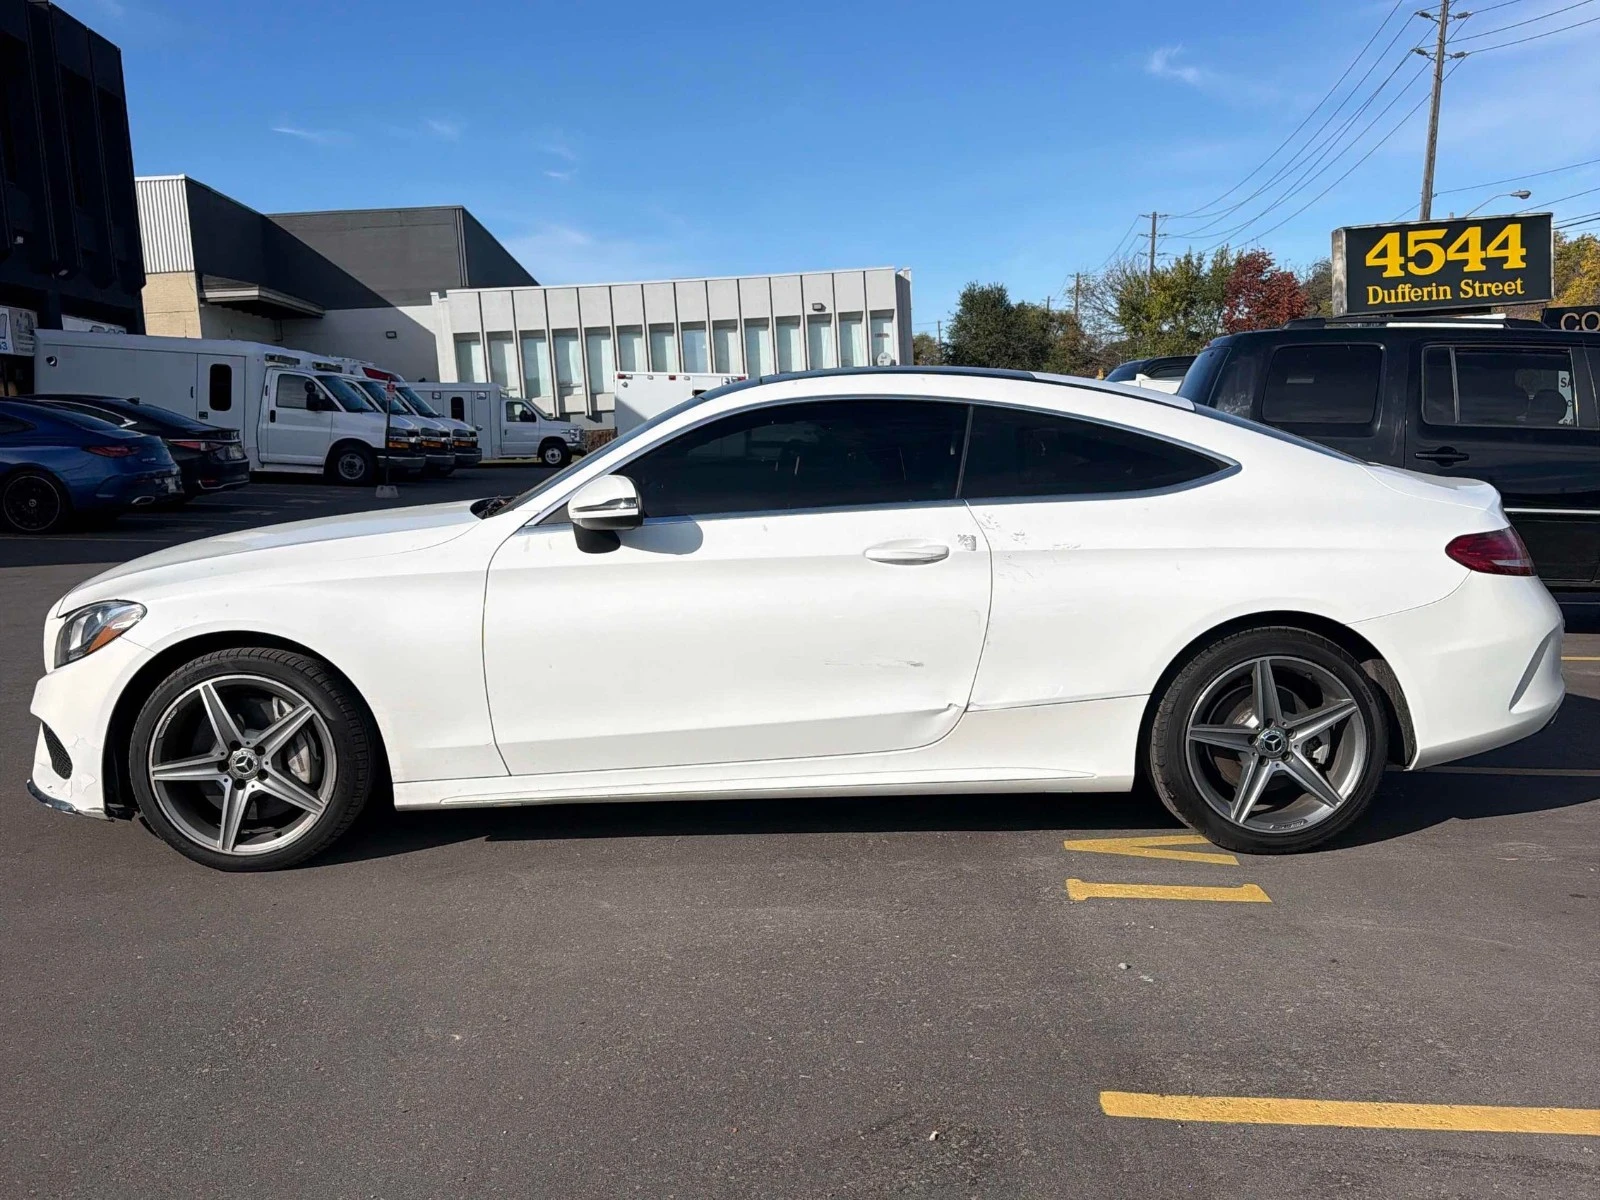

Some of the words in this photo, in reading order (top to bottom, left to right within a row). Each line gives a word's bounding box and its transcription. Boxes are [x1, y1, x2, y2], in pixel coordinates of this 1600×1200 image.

[1365, 223, 1527, 278] 4544
[1367, 282, 1453, 305] Dufferin
[1460, 277, 1525, 299] Street
